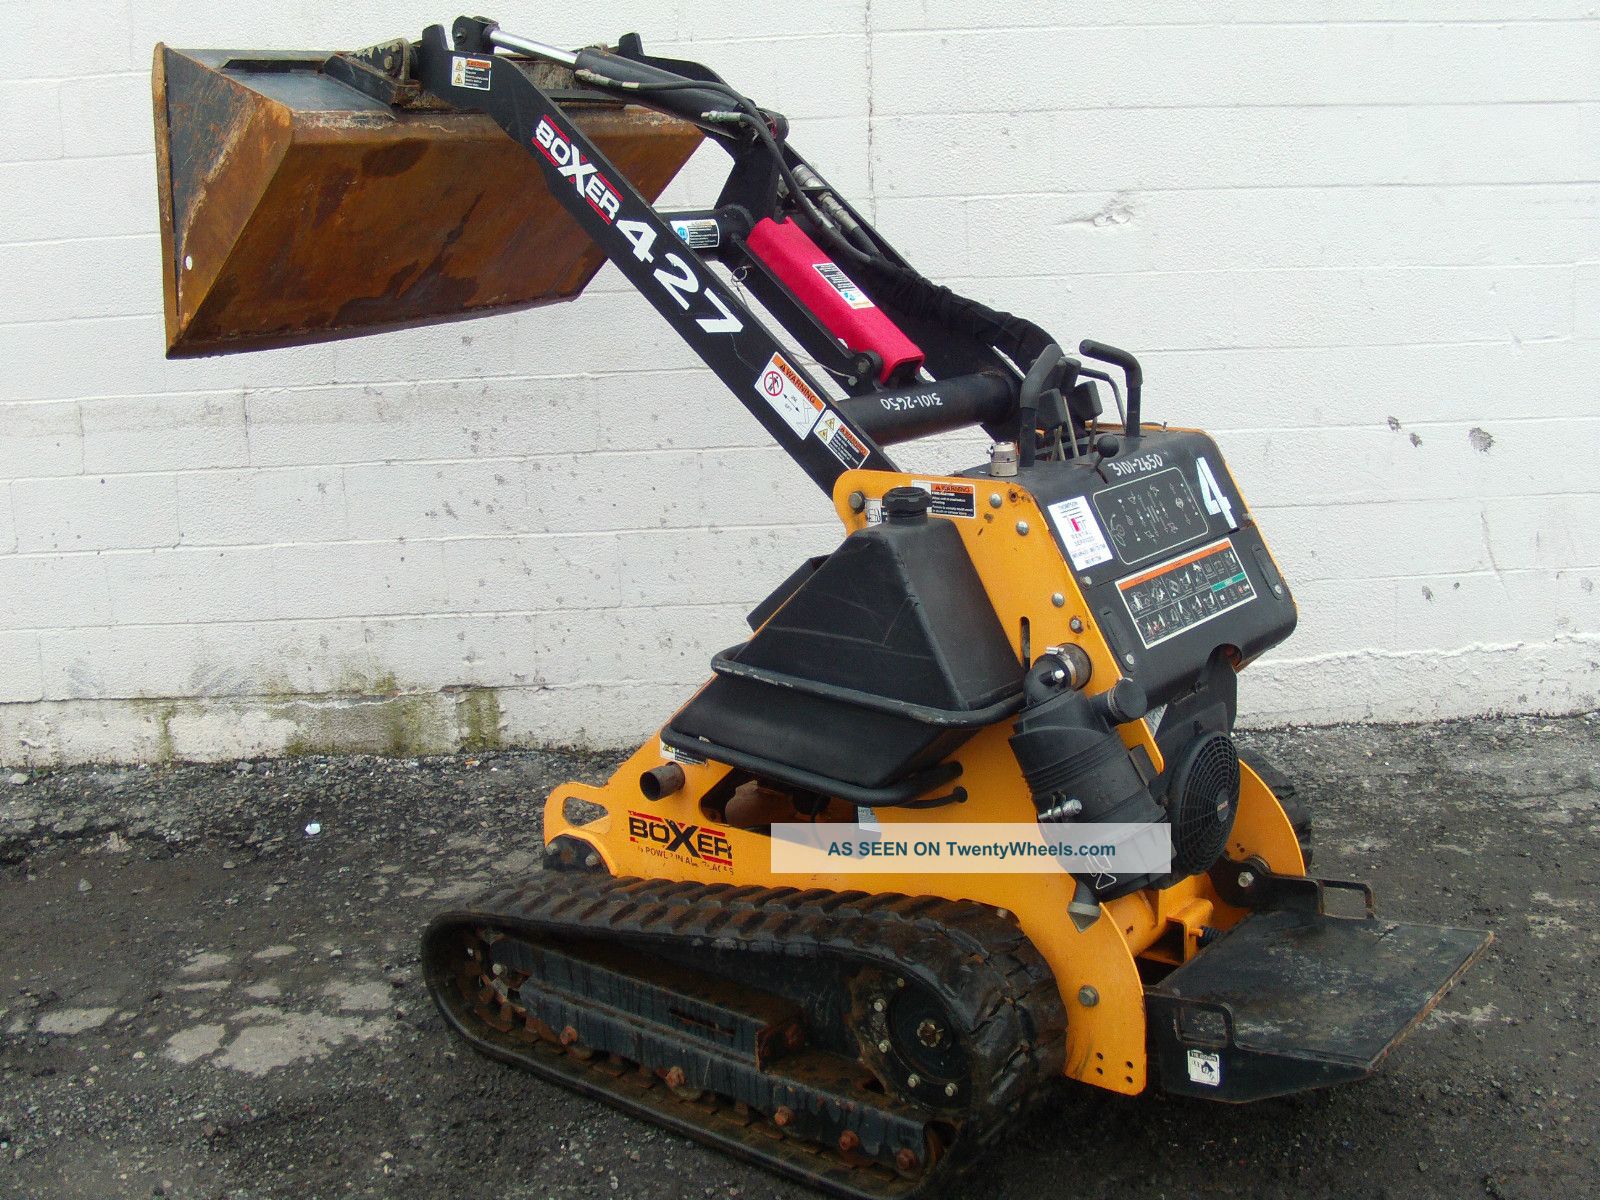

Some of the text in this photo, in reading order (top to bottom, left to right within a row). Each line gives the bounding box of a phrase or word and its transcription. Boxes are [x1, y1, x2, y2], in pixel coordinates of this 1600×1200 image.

[535, 119, 744, 333] BOXER 427
[785, 369, 816, 404] WARNING
[880, 392, 943, 411] 3101-2650
[1107, 453, 1163, 477] 3101-2650
[1195, 456, 1238, 529] 4
[628, 816, 733, 860] BOXER
